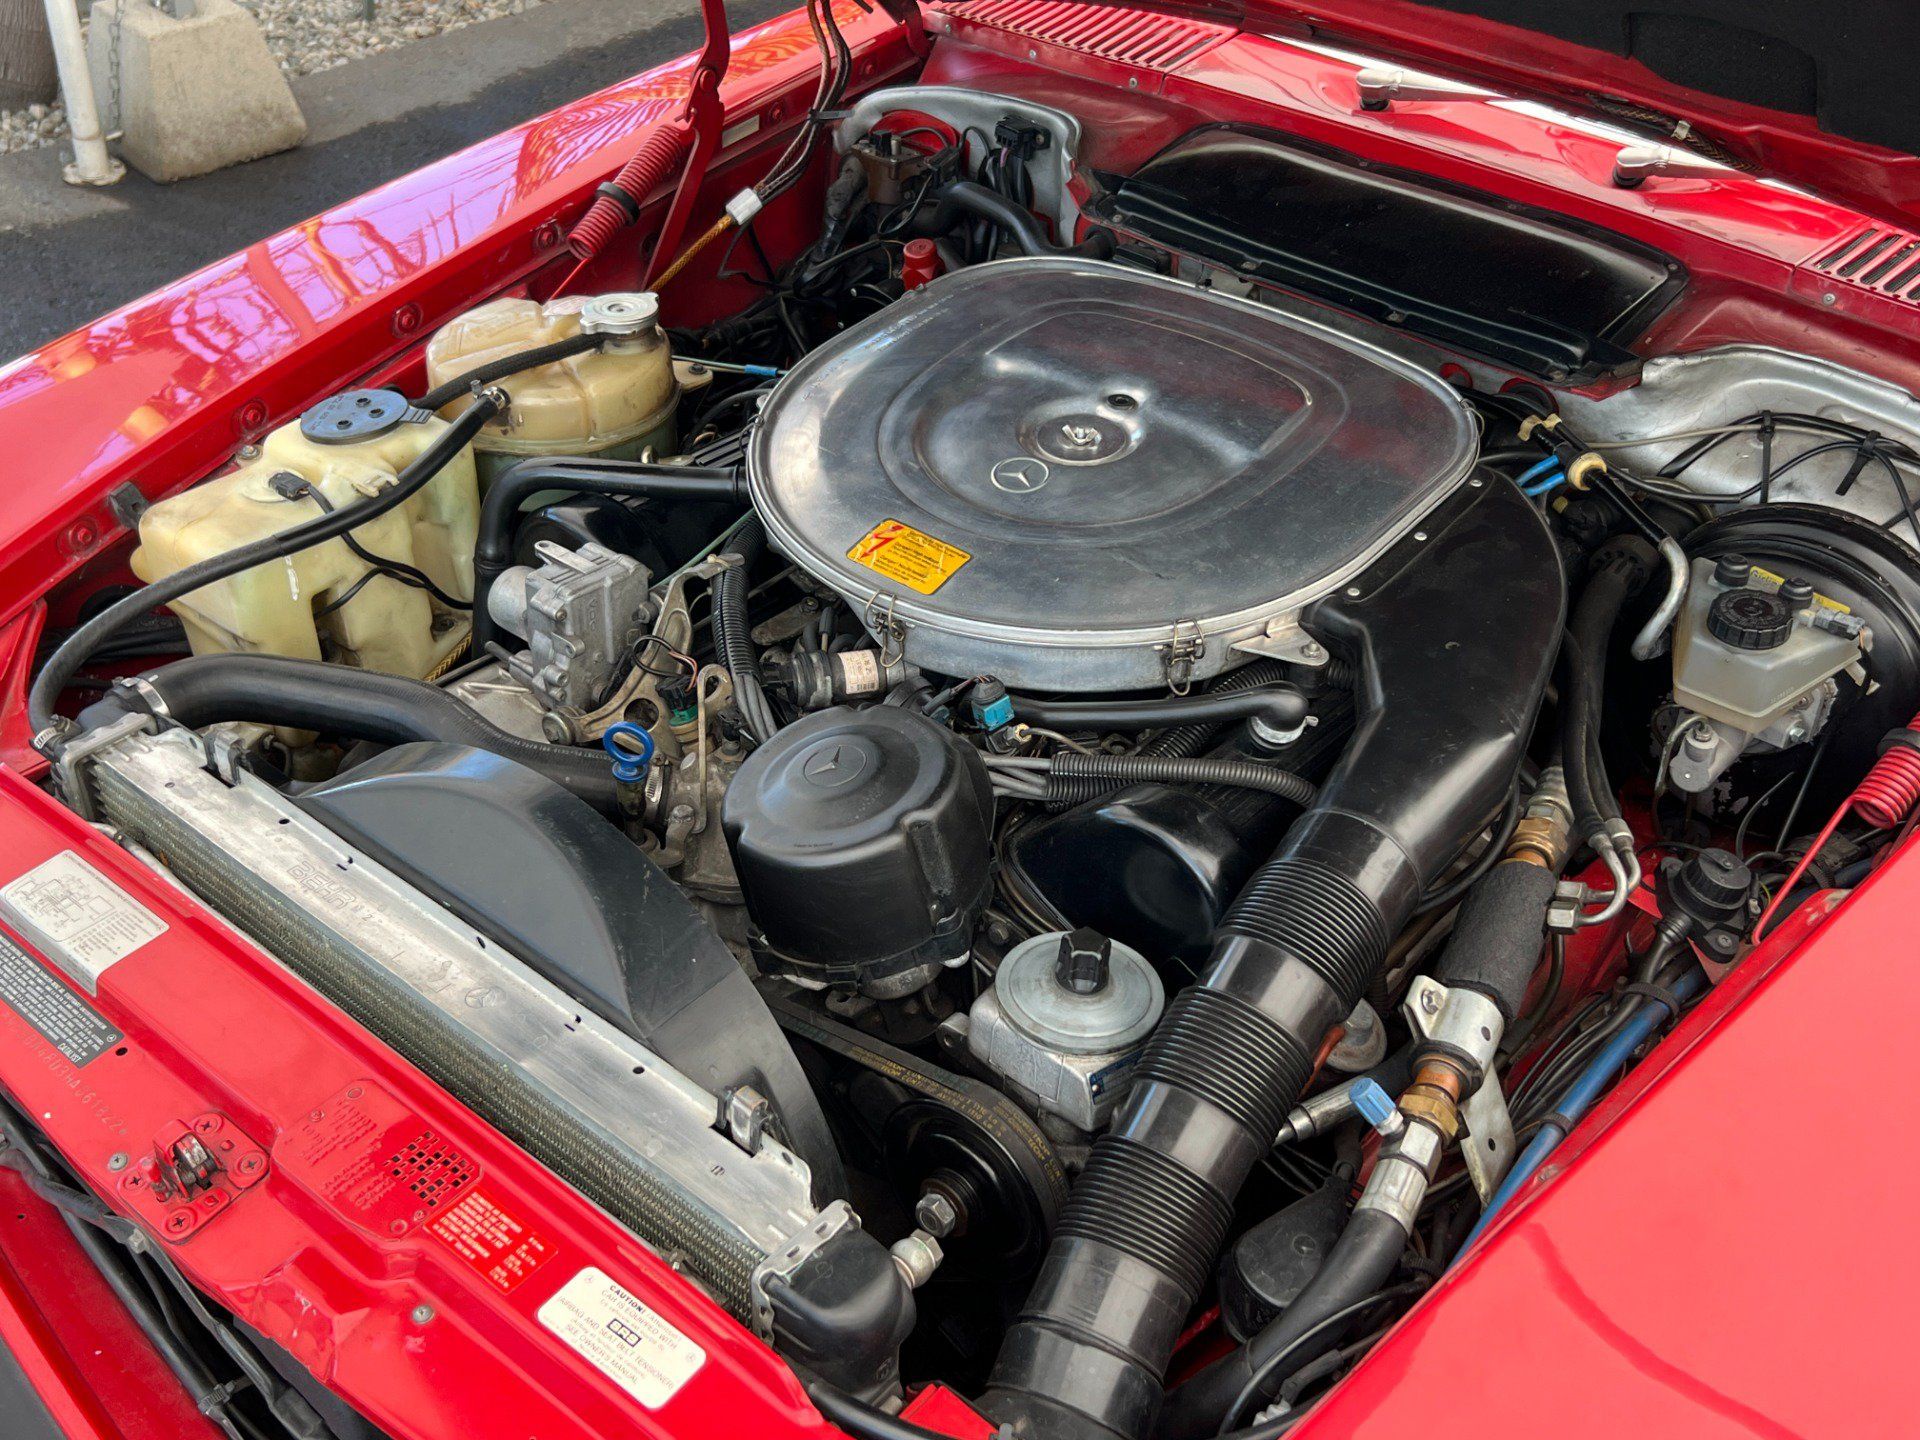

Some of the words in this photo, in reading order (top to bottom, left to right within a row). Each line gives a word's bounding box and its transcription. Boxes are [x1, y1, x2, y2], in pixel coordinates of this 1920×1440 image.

[287, 860, 356, 910] BEHR
[600, 1289, 617, 1303] CAR
[623, 1307, 659, 1335] EQUIPPED
[658, 1333, 677, 1349] WITH
[608, 1284, 646, 1314] CAUTION!
[564, 1323, 579, 1336] SEE
[609, 1359, 639, 1384] MANUAL
[583, 1316, 600, 1330] AND
[598, 1327, 618, 1344] SEAT
[615, 1341, 635, 1357] BELT
